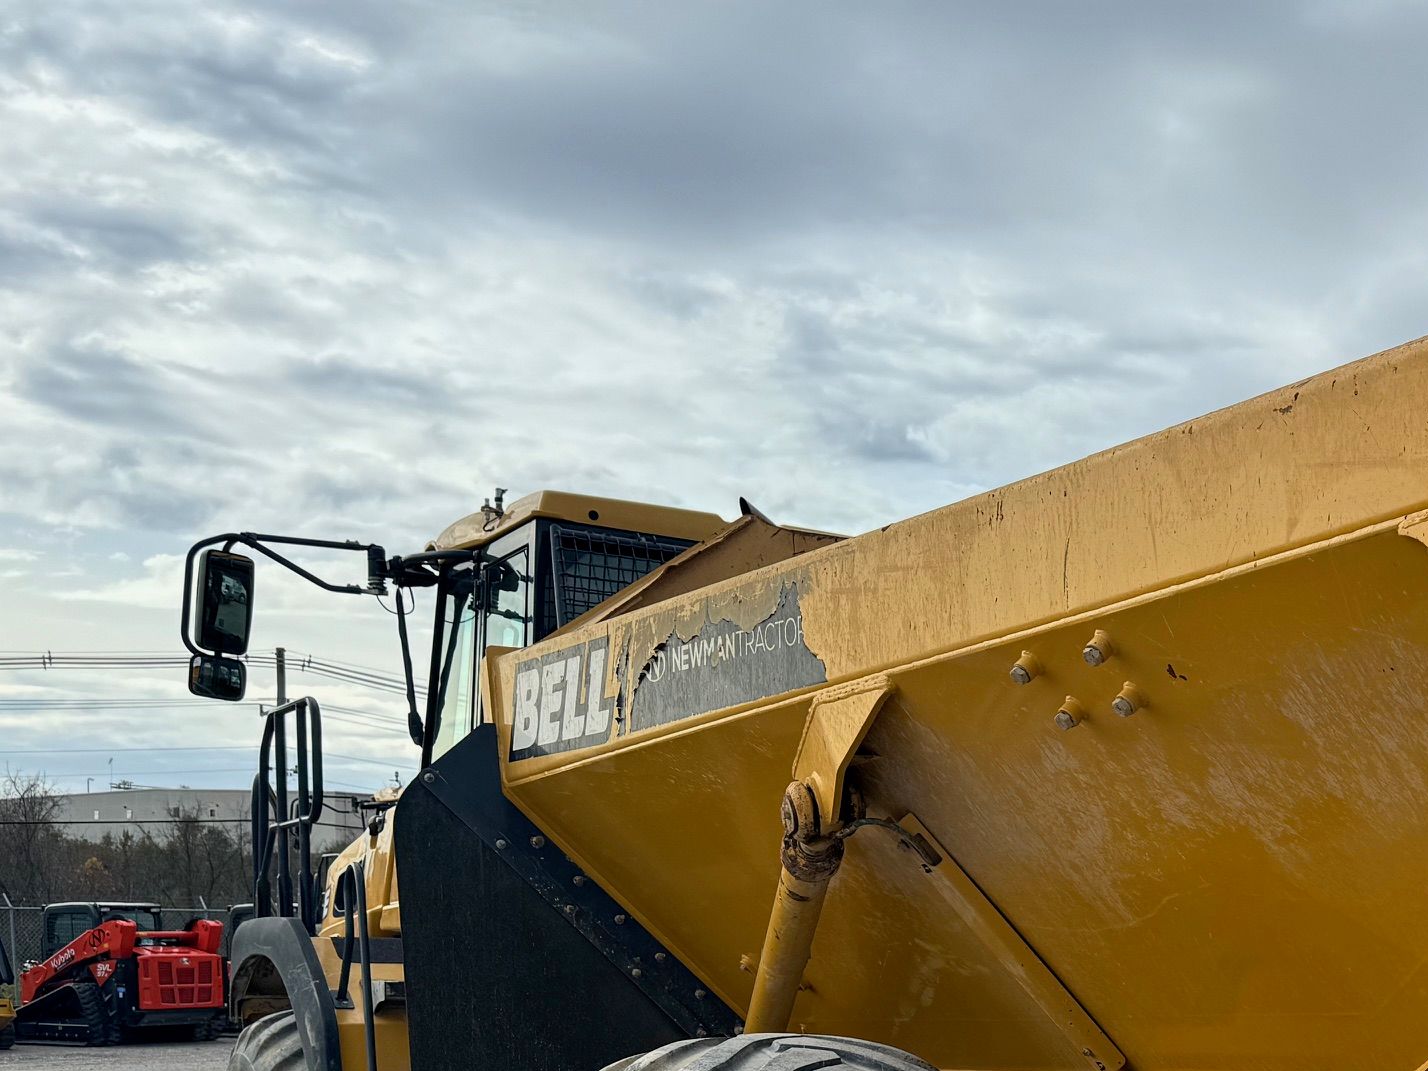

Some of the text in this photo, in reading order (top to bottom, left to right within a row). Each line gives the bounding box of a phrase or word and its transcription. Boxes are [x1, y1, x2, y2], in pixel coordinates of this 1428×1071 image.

[512, 648, 610, 751] BELL
[50, 948, 76, 968] Kubota
[97, 963, 112, 971] SVL
